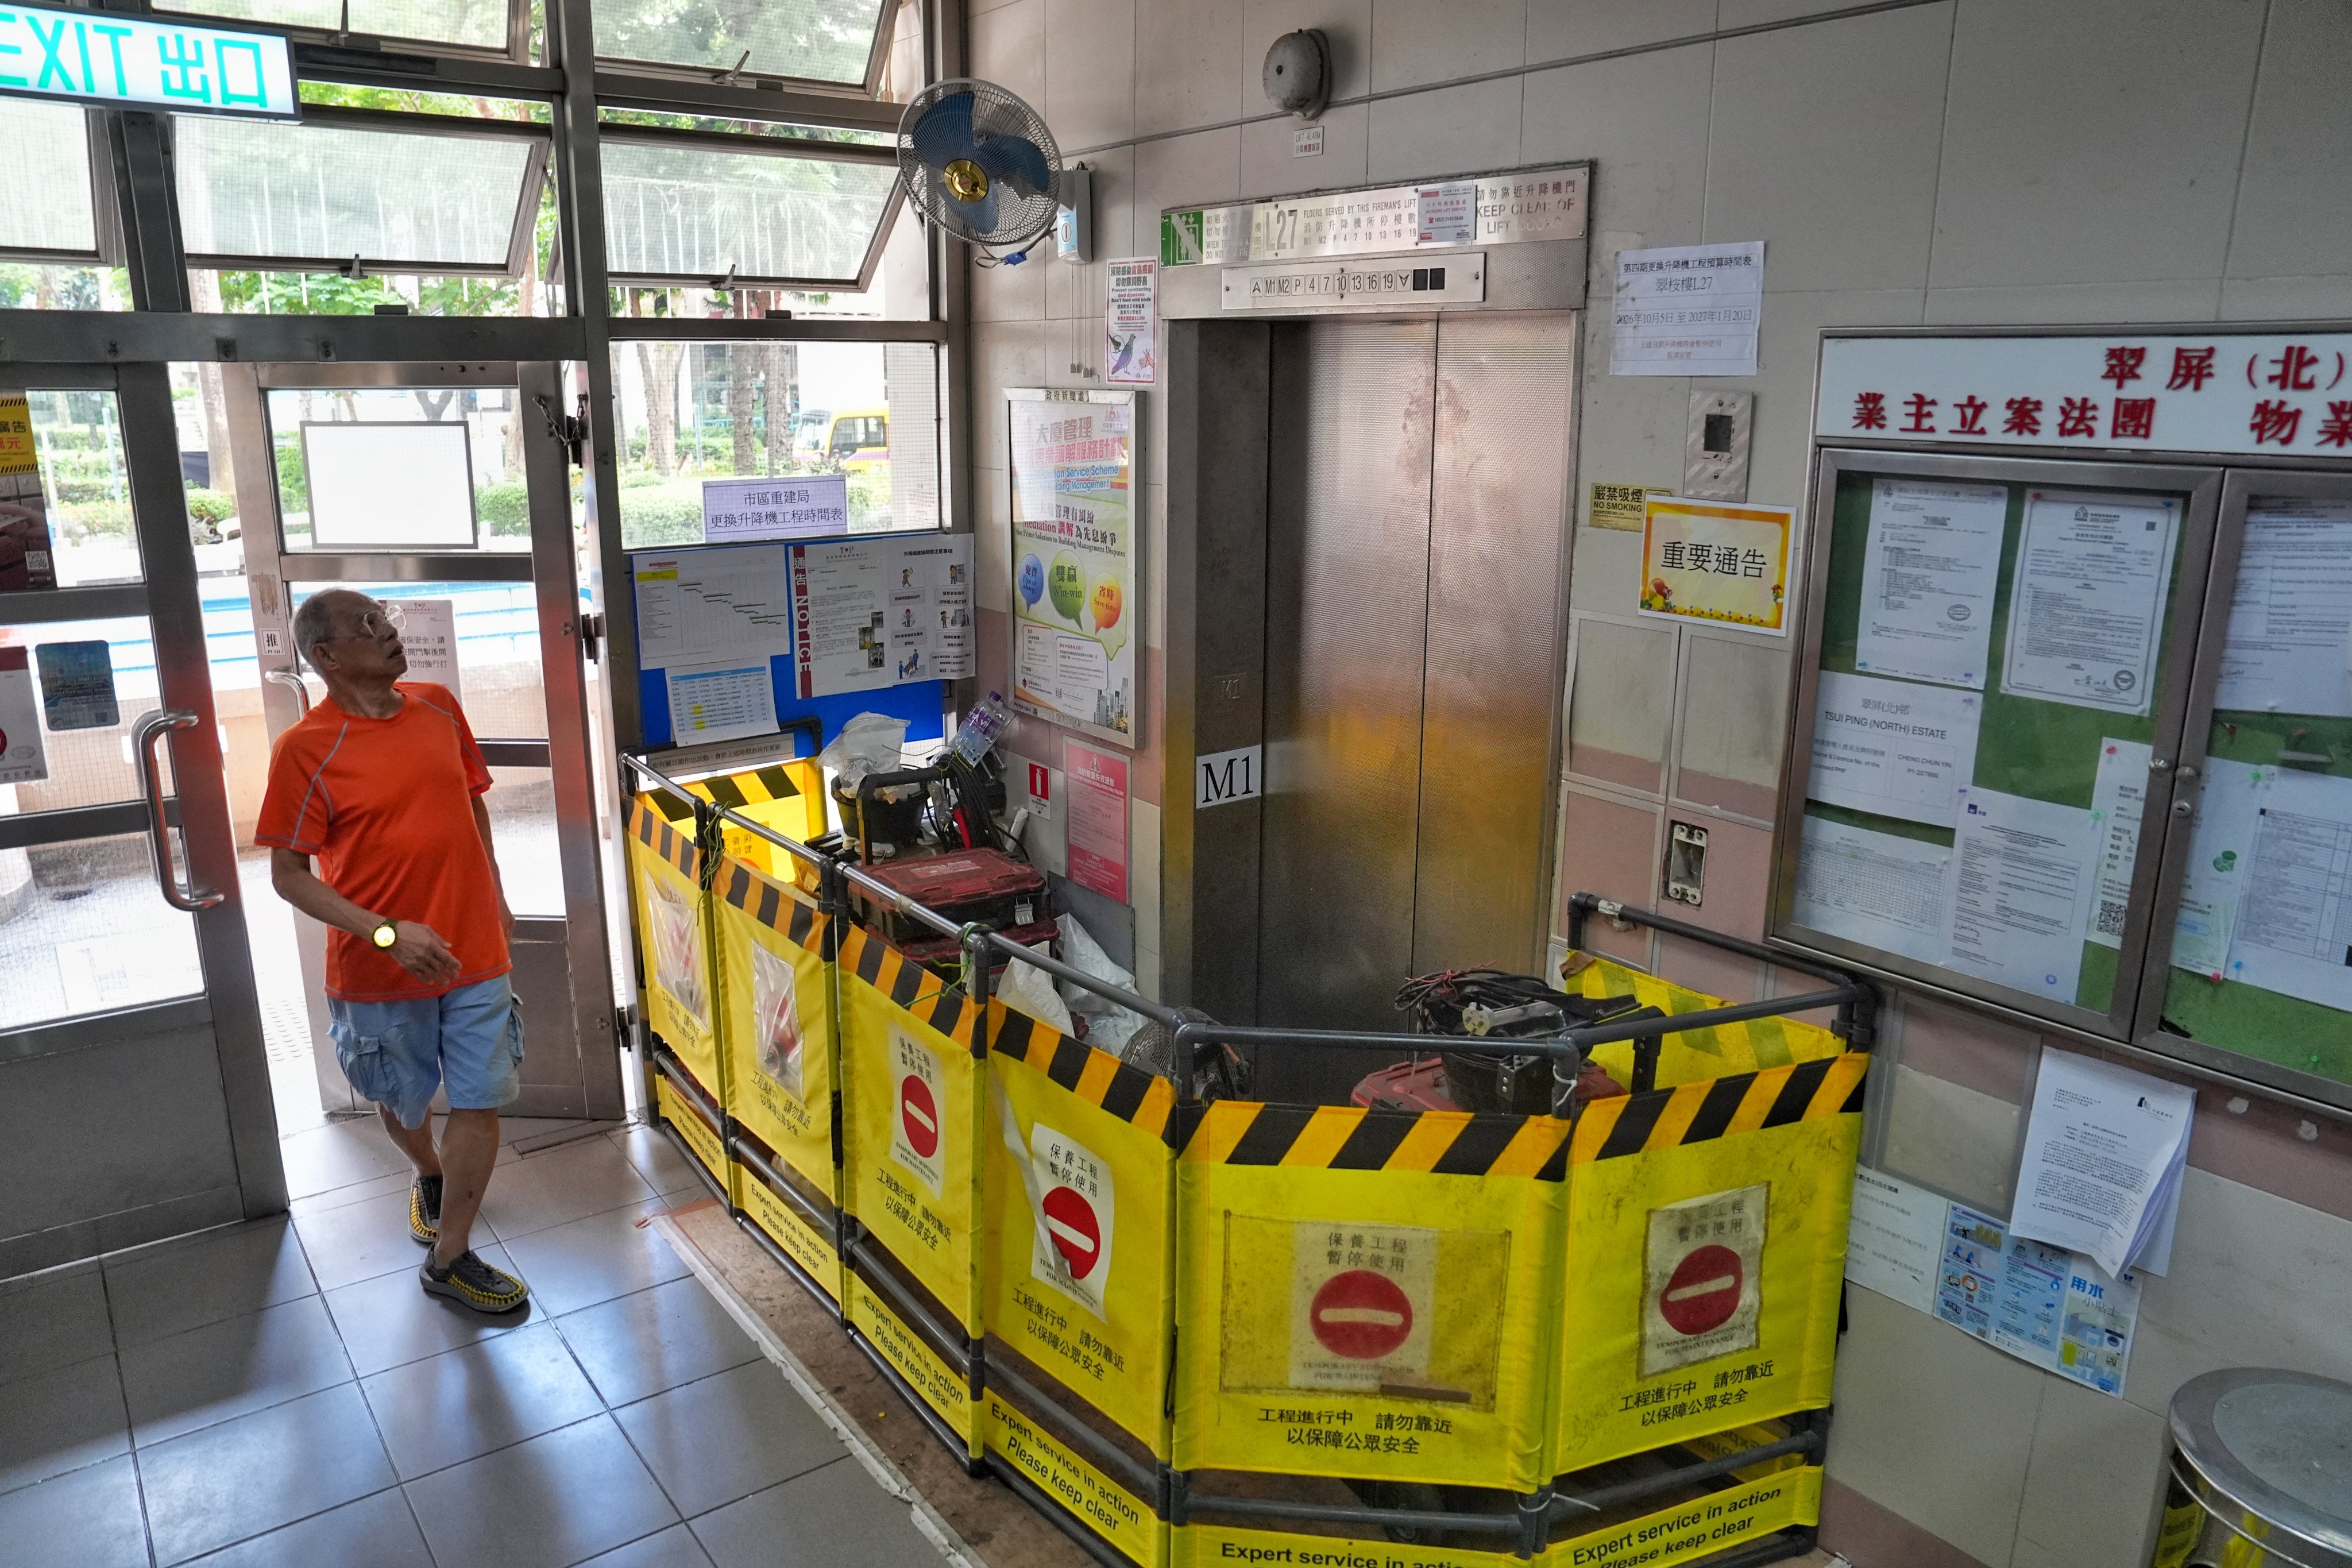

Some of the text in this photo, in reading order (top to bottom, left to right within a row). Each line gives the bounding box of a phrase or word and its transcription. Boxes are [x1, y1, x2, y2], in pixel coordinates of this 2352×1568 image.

[0, 13, 268, 109] EXIT 出口
[1477, 180, 1575, 202] 請勿靠近升降機門
[1304, 199, 1416, 218] FLOORS SERVED BY THIS FIREMAN'S LIFT
[1477, 198, 1575, 218] KEEP OF
[1266, 210, 1297, 251] L27
[1304, 212, 1416, 234] 消防升降機所停樓數
[1487, 221, 1511, 234] LIFT
[1206, 237, 1261, 249] WHEN FIRE
[1304, 236, 1311, 245] M1
[1318, 235, 1326, 245] M2
[1333, 235, 1337, 243] P
[1354, 233, 1357, 241] 7
[1365, 231, 1372, 240] 10
[1380, 230, 1387, 239] 13
[1395, 229, 1401, 238] 16
[1409, 228, 1416, 237] 19
[1623, 256, 1752, 273] 第四期更換升降機工程預算時間表
[1265, 273, 1393, 295] M1 M2 P 4 7 10 13 16 19
[1677, 312, 1686, 323] 至
[1046, 390, 1084, 402] 政府新聞處
[1036, 416, 1094, 445] 大廈管理
[1851, 392, 2352, 448] 業主立案法團 物業
[1066, 465, 1119, 478] Service Scheme
[1048, 478, 1110, 493] Building Management
[1594, 485, 1643, 503] 嚴禁吸煙
[744, 489, 809, 507] 市區重建局
[1606, 502, 1642, 512] SMOKING
[710, 507, 843, 530] 更換升降機工程時間表
[1022, 520, 1056, 534] Mediation
[1023, 529, 1034, 539] Prime
[1035, 531, 1052, 542] Solution
[1059, 537, 1076, 550] Building
[1077, 540, 1104, 553] Management
[1106, 546, 1126, 558] Disputes
[1025, 565, 1037, 578] 免費
[1661, 541, 1767, 578] 重要通告
[1022, 576, 1033, 584] Free
[1056, 565, 1077, 583] 雙贏
[1052, 586, 1082, 598] Win-win
[1099, 585, 1114, 601] 省時
[793, 557, 812, 673] 通告 NOTICE
[1094, 597, 1117, 612] Save time
[266, 633, 279, 647] 推
[1861, 697, 1910, 716] 翠屏(北)邨
[1824, 711, 1947, 740] TSUI PING (NORTH) ESTATE
[1813, 750, 1828, 759] Name
[1898, 753, 1952, 768] CHENG CHUN YIN
[1202, 755, 1253, 804] M1
[899, 1036, 931, 1068] 保養工程
[900, 1051, 932, 1084] 暫停使用
[760, 1093, 800, 1138] 以保障公眾安全
[783, 1099, 812, 1130] 請勿靠近
[1050, 1142, 1098, 1180] 保養工程
[1050, 1160, 1098, 1198] 暫停使用
[876, 1167, 951, 1243] 工程進行中 請勿靠近
[751, 1183, 828, 1263] Expert service in action
[885, 1195, 939, 1252] 以保障公眾安全
[763, 1209, 819, 1272] Please keep clear
[1327, 1231, 1408, 1255] 保養工程
[1327, 1250, 1405, 1273] 暫停使用
[1045, 1270, 1058, 1284] FOR
[2071, 1275, 2104, 1299] 用水
[2083, 1297, 2119, 1318] 小貼士
[1012, 1288, 1125, 1374] 工程進行中 請勿靠近
[863, 1294, 963, 1404] Expert service in action
[1027, 1318, 1104, 1381] 以保障公眾安全
[875, 1324, 949, 1409] Please keep clear
[1618, 1360, 1774, 1413] 工程進行中 請勿靠近
[1641, 1388, 1749, 1427] 以保障公眾安全
[1258, 1407, 1453, 1435] 工程進行中 請勿靠近
[1287, 1427, 1421, 1454] 以保障公眾安全
[991, 1402, 1140, 1525] Expert service in action
[1007, 1436, 1119, 1531] Please keep clear
[1573, 1488, 1782, 1567] Expert service in action
[1600, 1516, 1755, 1568] Please keep clear
[1221, 1542, 1404, 1568] Expert service in
